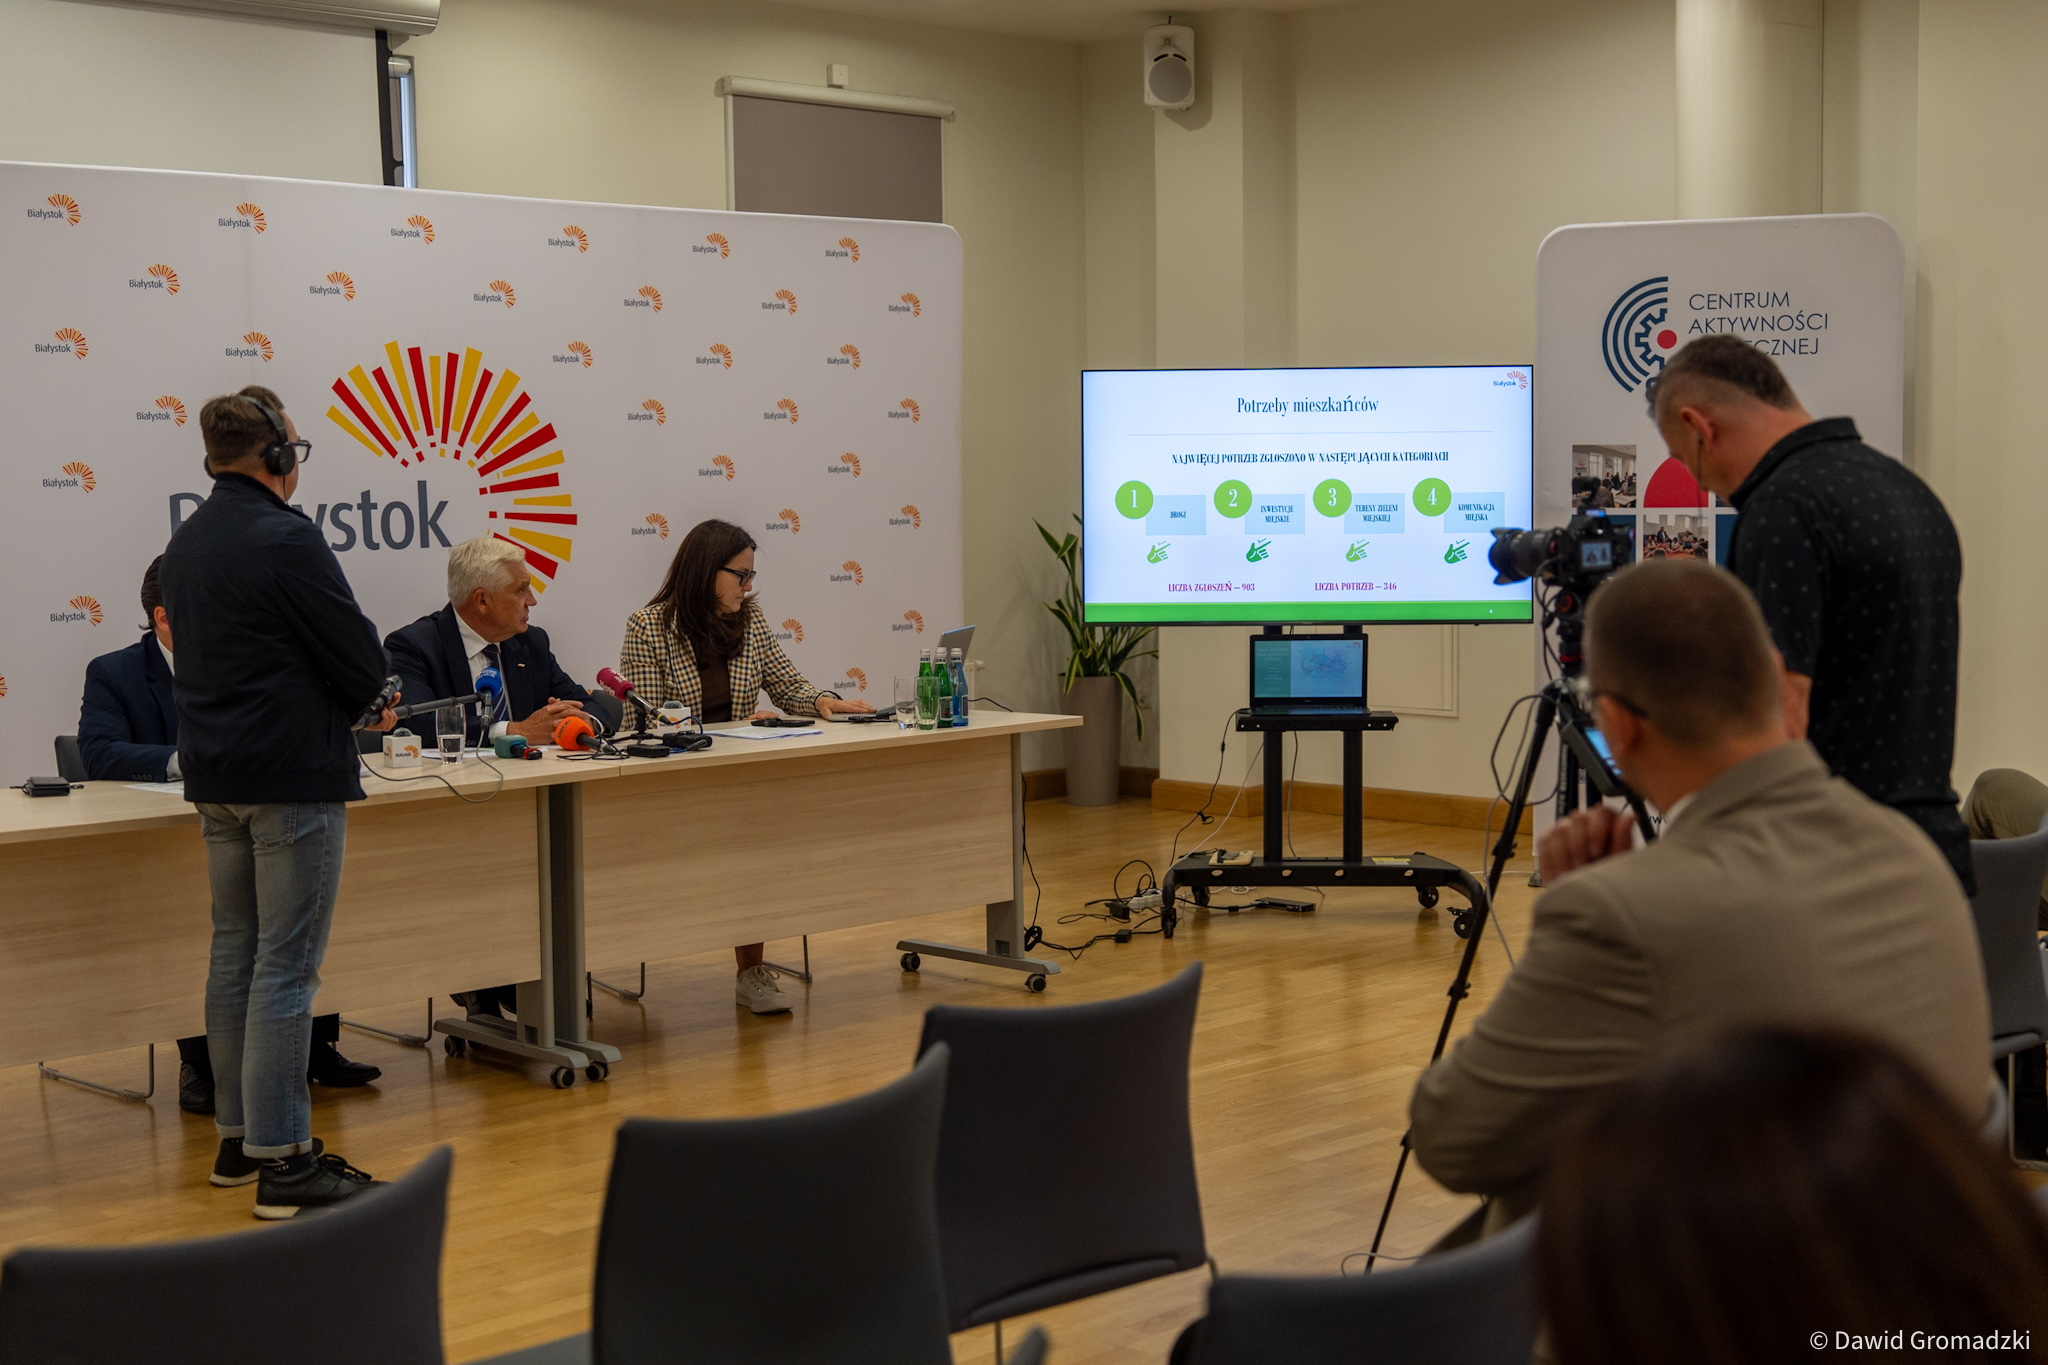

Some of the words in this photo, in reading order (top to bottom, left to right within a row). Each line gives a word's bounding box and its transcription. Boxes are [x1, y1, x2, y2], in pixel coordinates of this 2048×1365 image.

[27, 208, 64, 221] Białystok
[218, 217, 252, 229] Białystok
[390, 228, 421, 239] Białystok
[548, 238, 576, 248] Białystok
[128, 278, 164, 291] Białystok
[309, 285, 341, 297] Białystok
[473, 293, 503, 304] Białystok
[623, 298, 651, 309] Białystok
[1689, 291, 1790, 311] CENTRUM
[1688, 310, 1828, 334] AKTYWNOŚCI
[34, 343, 72, 355] Białystok
[225, 347, 259, 359] Białystok
[1743, 338, 1819, 356] CZNEJ
[552, 354, 581, 365] Białystok
[1237, 397, 1289, 417] Potrzeby
[1293, 394, 1379, 413] mieszkańców
[136, 411, 171, 423] Białystok
[1172, 453, 1220, 466] NAJWIĘCEJ
[1222, 453, 1258, 463] POTRZEB
[1308, 452, 1318, 463] W
[1319, 451, 1390, 465] NASTĘPUJĄCYCH
[1392, 451, 1449, 462] KATEGORIACH
[42, 477, 79, 490] Białystok
[1131, 489, 1138, 508] 1
[1229, 488, 1238, 507] 2
[1328, 487, 1338, 507] 3
[1427, 486, 1437, 506] 4
[1260, 505, 1294, 513] INWESTYCJE
[1355, 504, 1377, 512] TERENY
[1377, 504, 1398, 512] ZIELENI
[1458, 503, 1495, 512] KOMUNIKACJA
[1170, 511, 1186, 519] DROGI
[1265, 515, 1290, 523] MIEJSKIE
[1363, 514, 1391, 522] MIEJSKIEJ
[1465, 513, 1489, 522] MIEJSKA
[1168, 583, 1193, 592] LICZBA
[1242, 583, 1255, 592] 903
[1315, 582, 1339, 591] LICZBA
[1341, 582, 1374, 591] POTRZEB
[1383, 582, 1397, 591] 346
[49, 611, 87, 624] Białystok
